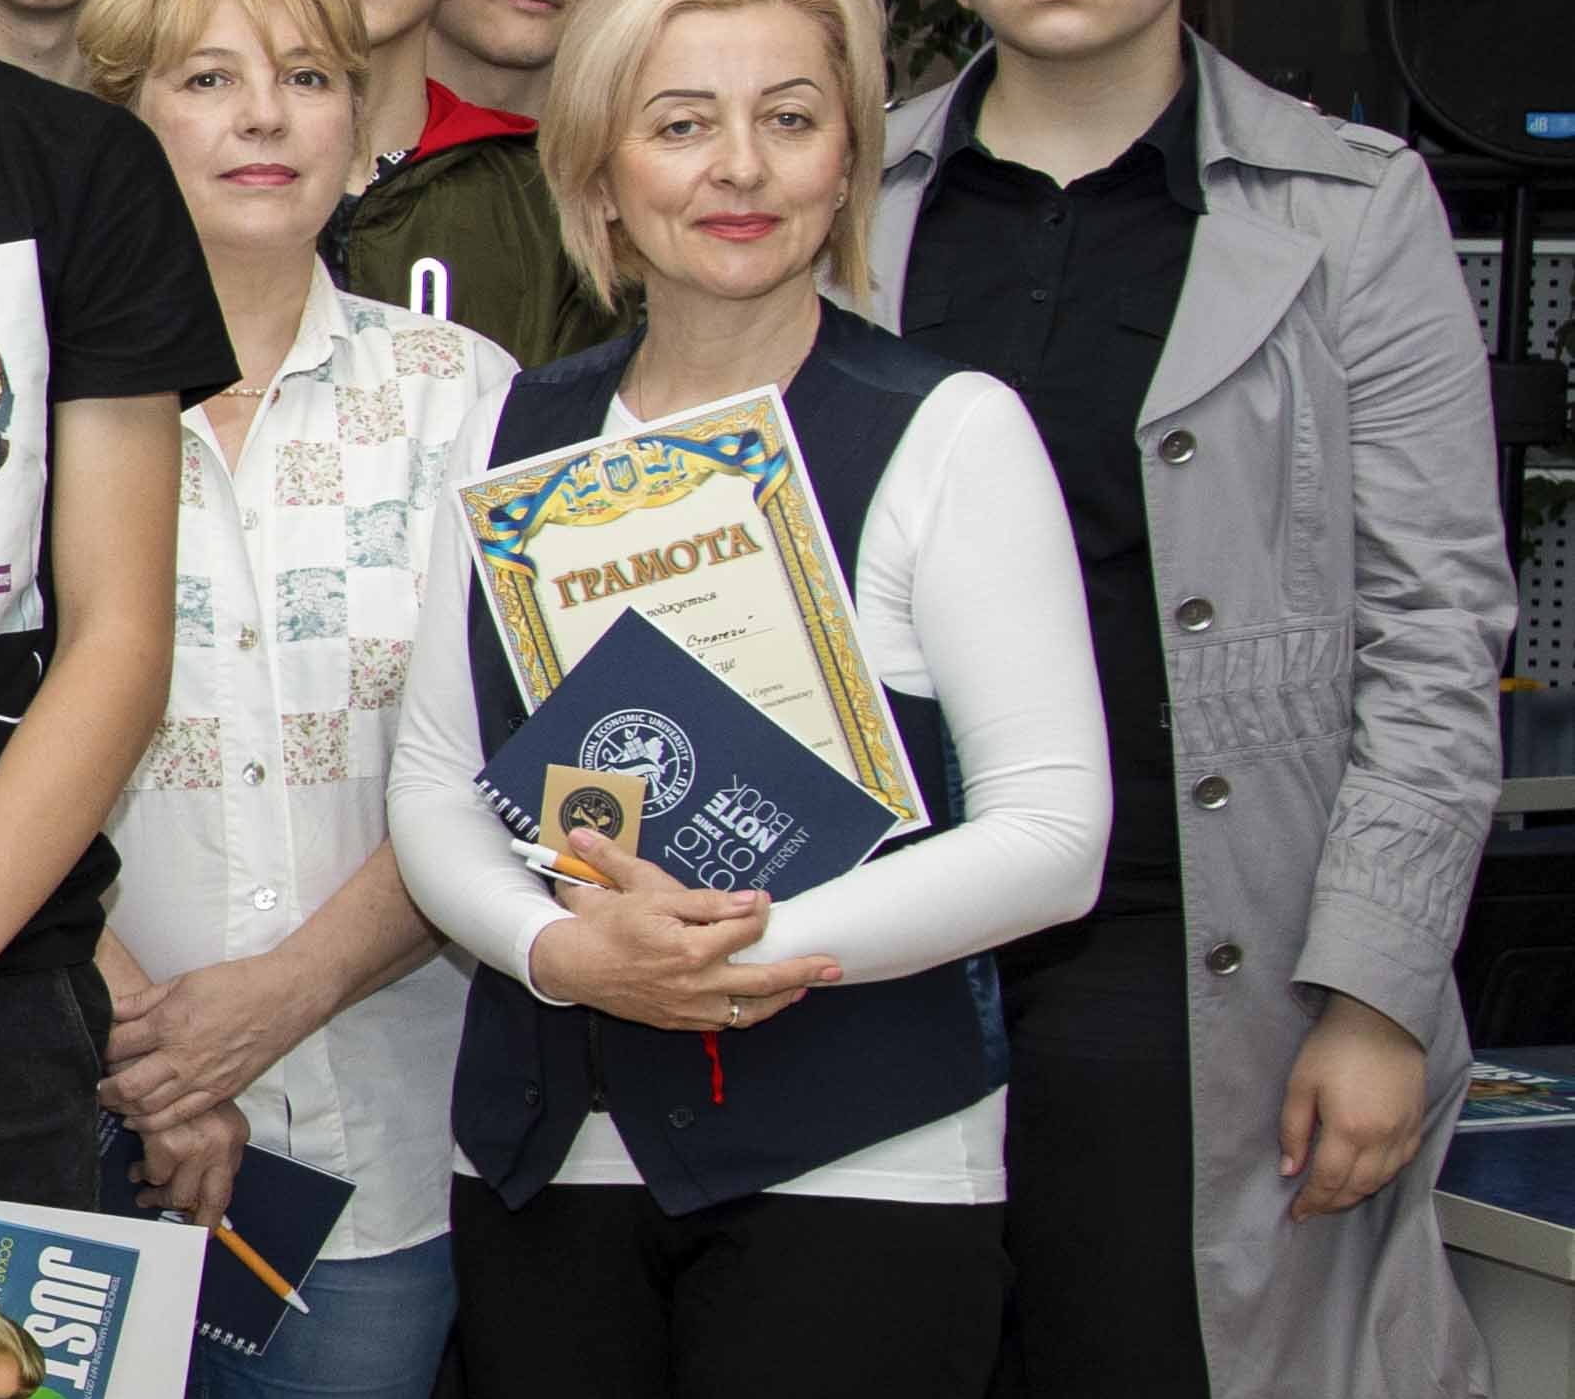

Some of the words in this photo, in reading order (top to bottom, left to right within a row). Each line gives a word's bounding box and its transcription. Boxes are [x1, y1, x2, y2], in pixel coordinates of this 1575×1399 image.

[551, 522, 762, 610] ГРАМОТА
[594, 713, 644, 738] ECONOMIC
[649, 716, 688, 759] UNIVERSITY
[657, 776, 686, 807] TNEU
[703, 787, 778, 857] NOTE
[719, 774, 793, 836] BOOK
[665, 825, 711, 867] 19
[691, 811, 724, 842] SINCE
[749, 824, 811, 893] DIFFERENT
[28, 1245, 109, 1391] JUST
